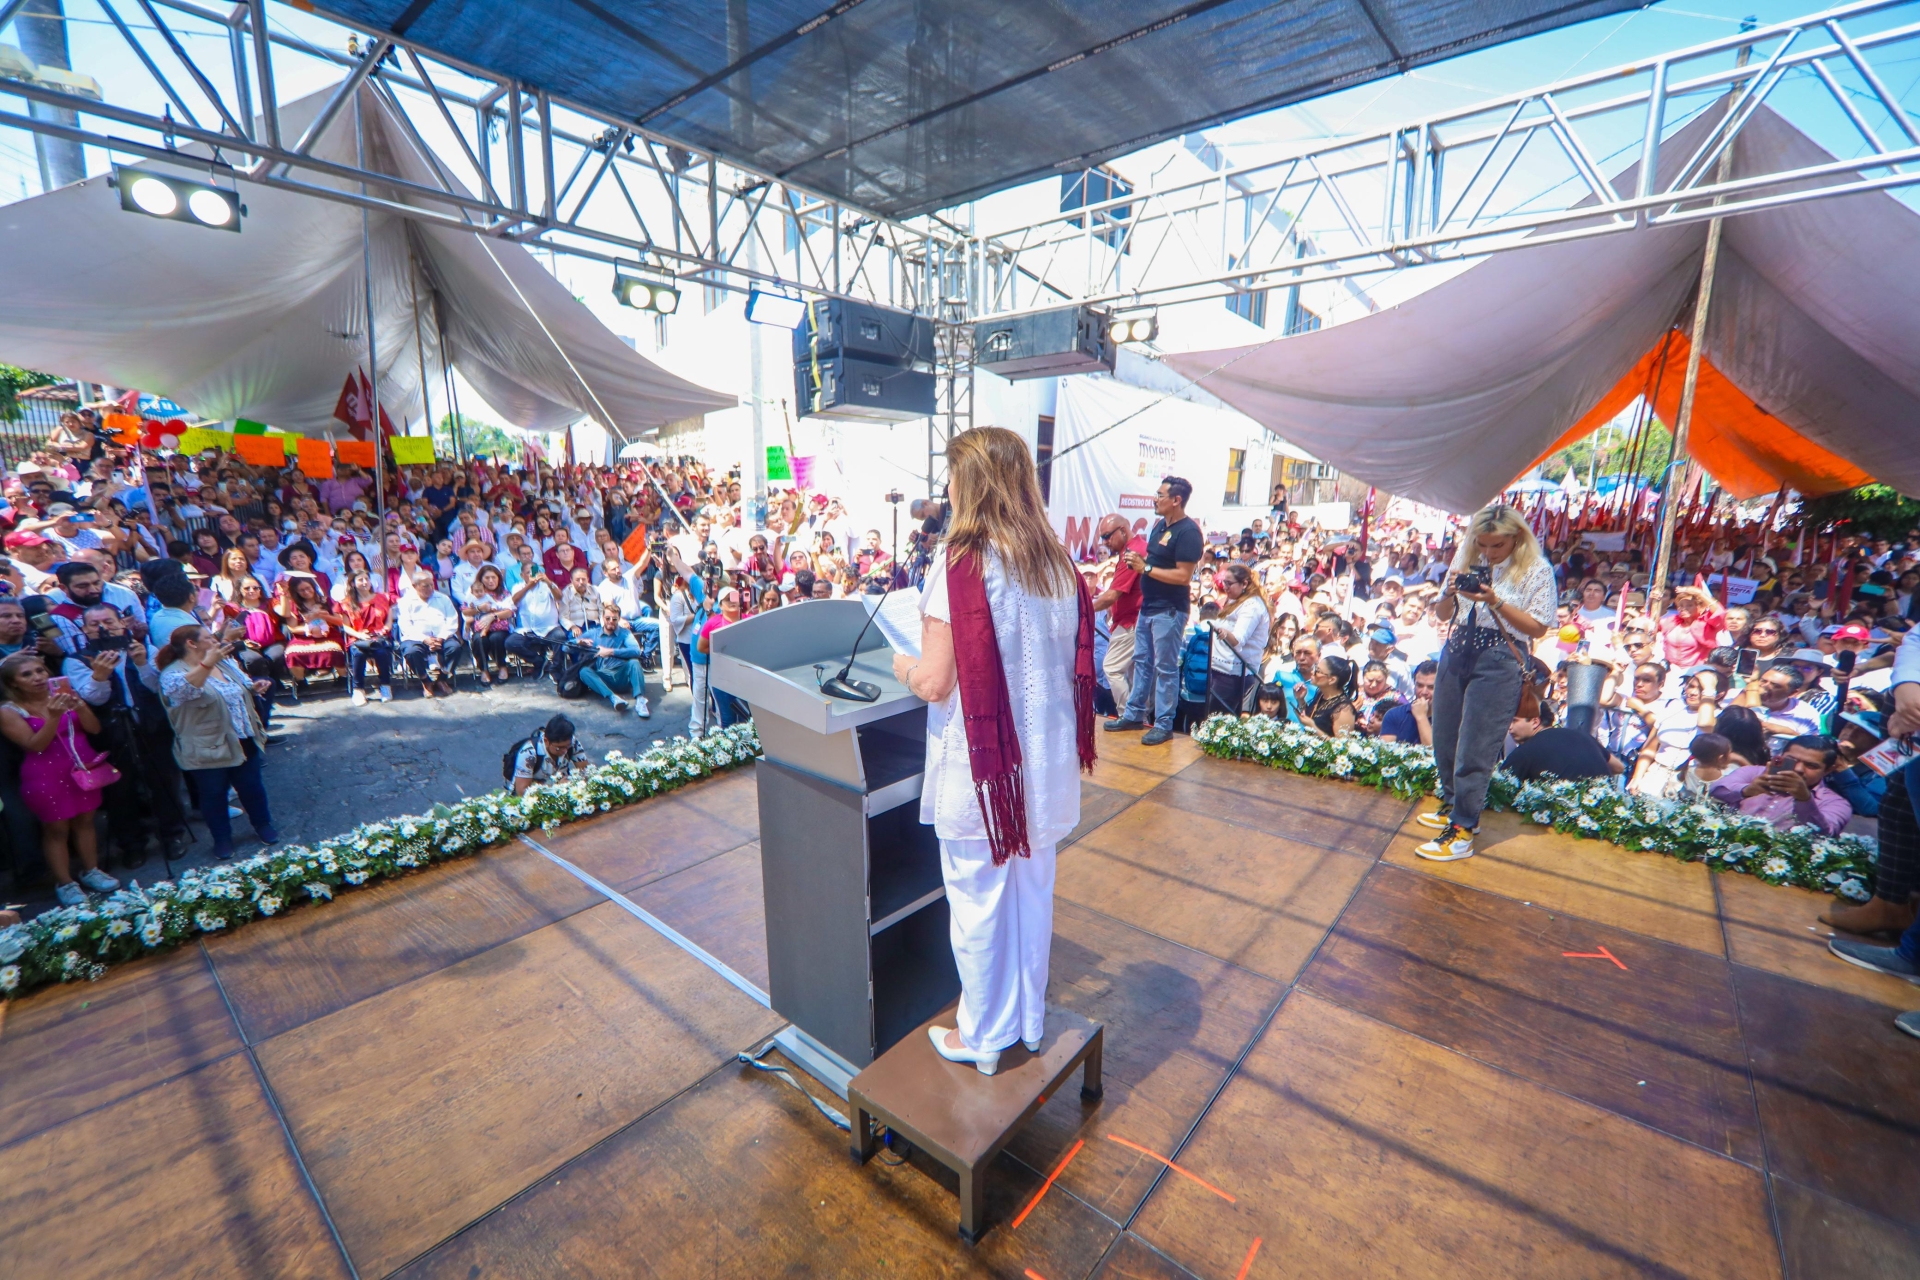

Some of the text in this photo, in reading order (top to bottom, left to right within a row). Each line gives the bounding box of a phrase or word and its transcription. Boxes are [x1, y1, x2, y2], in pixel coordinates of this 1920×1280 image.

[797, 14, 830, 35] KEEPER
[1048, 53, 1085, 72] KEEPER
[1139, 442, 1176, 461] morena
[1121, 497, 1145, 507] REGISTRO
